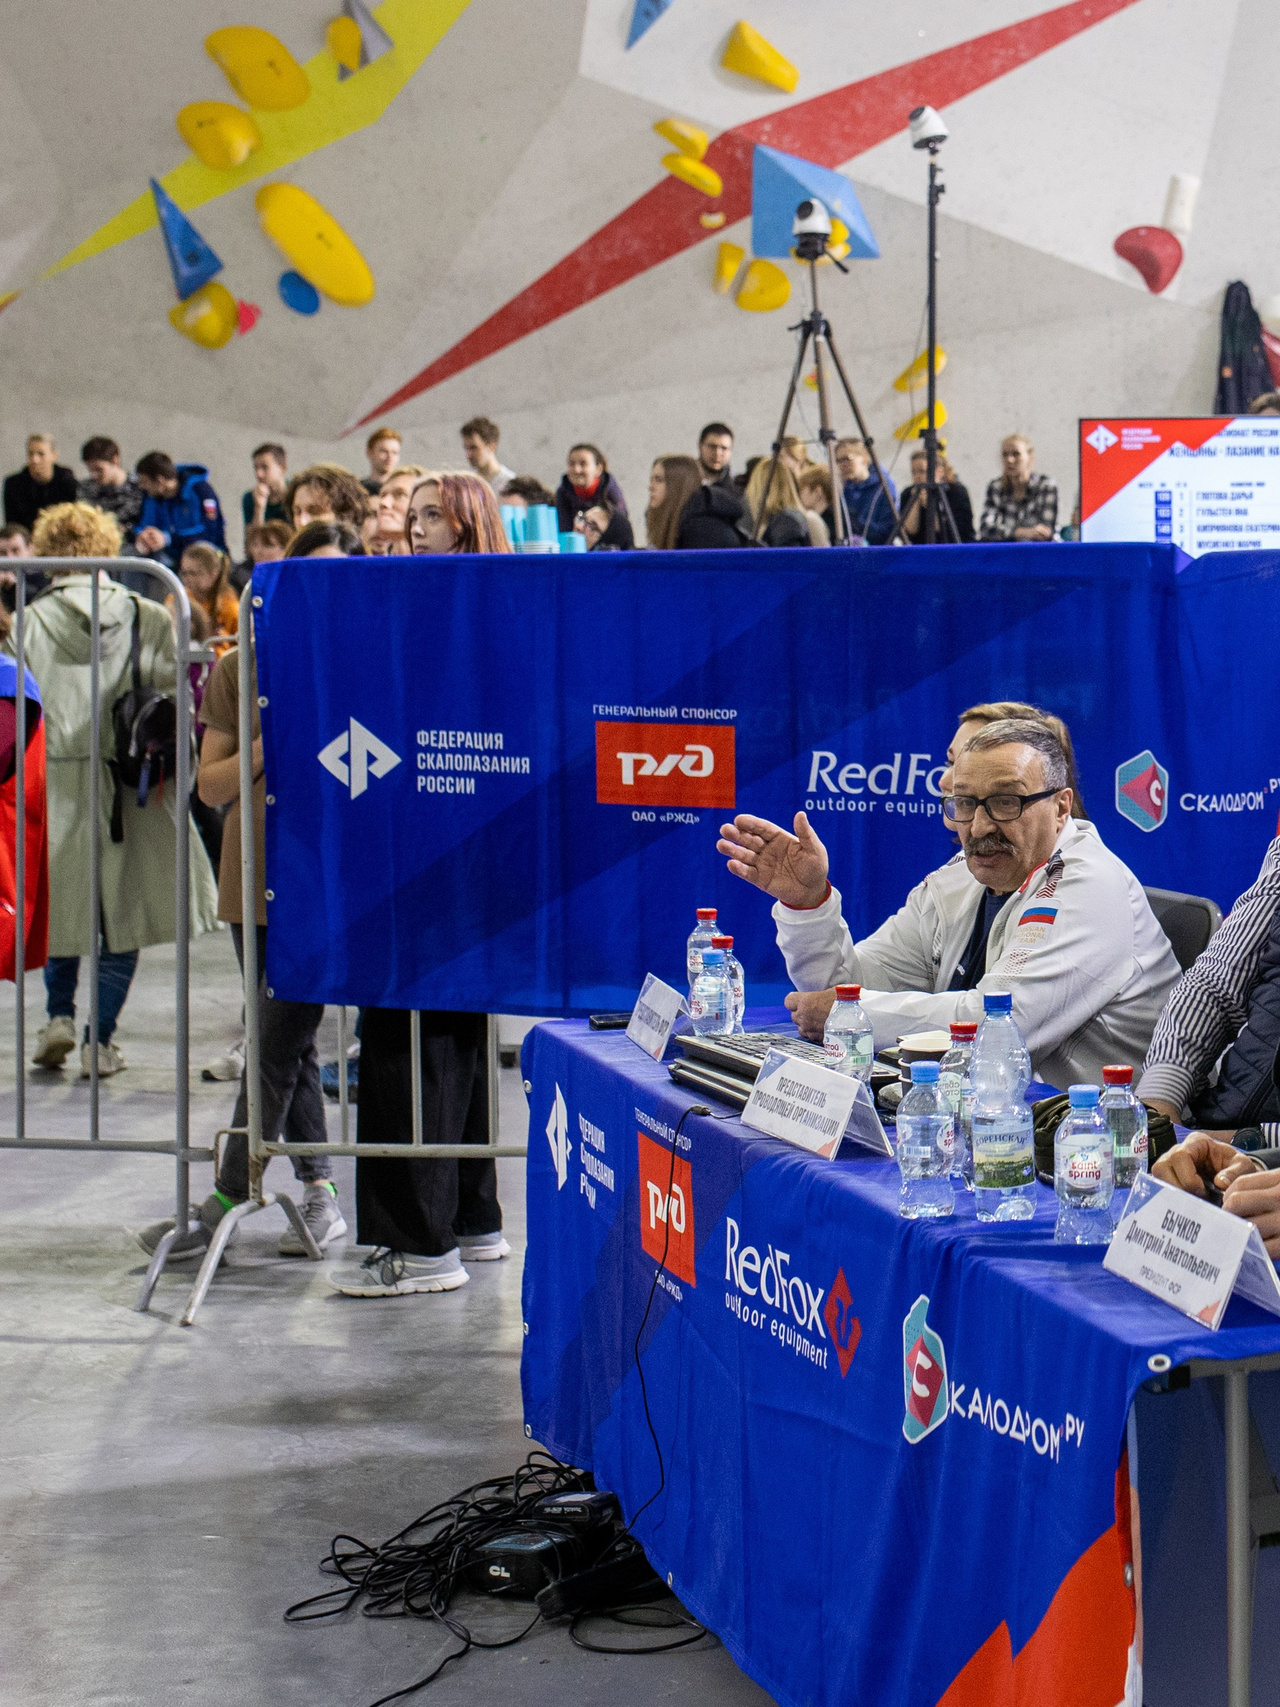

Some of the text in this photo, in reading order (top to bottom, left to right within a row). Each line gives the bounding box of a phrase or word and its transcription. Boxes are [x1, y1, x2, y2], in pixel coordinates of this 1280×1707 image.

[1225, 445, 1266, 458] ЛАЗАНИЕ
[1268, 445, 1280, 457] НА
[592, 704, 738, 720] ГЕНЕРАЛЬНЫЙ СПОНСОР
[416, 729, 504, 752] ФЕДЕРАЦИЯ
[416, 751, 531, 775] СКАЛОЛАЗАНИЯ
[416, 775, 476, 795] РОССИИ
[632, 810, 656, 823] ОАО
[805, 797, 943, 818] outdoor equip
[775, 1076, 828, 1109] ПРЕДСТАВИТЕЛЬ
[751, 1089, 840, 1137] ПРОВОДЯЩЕЙ ОРГАНИЗАЦИИ
[634, 1106, 692, 1152] ГЕНЕРАЛЬНЫЙ СПНСОР
[1068, 1169, 1101, 1180] spring
[1071, 1160, 1098, 1170] saint
[1161, 1208, 1202, 1244] БЫЧКОВ
[1125, 1219, 1221, 1284] Дмитрий Анатольевич
[725, 1216, 827, 1339] RedFox
[1139, 1264, 1182, 1295] ПРЕЗИДЕНТ ФСР
[725, 1292, 828, 1370] outoor equipment
[488, 1565, 511, 1578] CL
